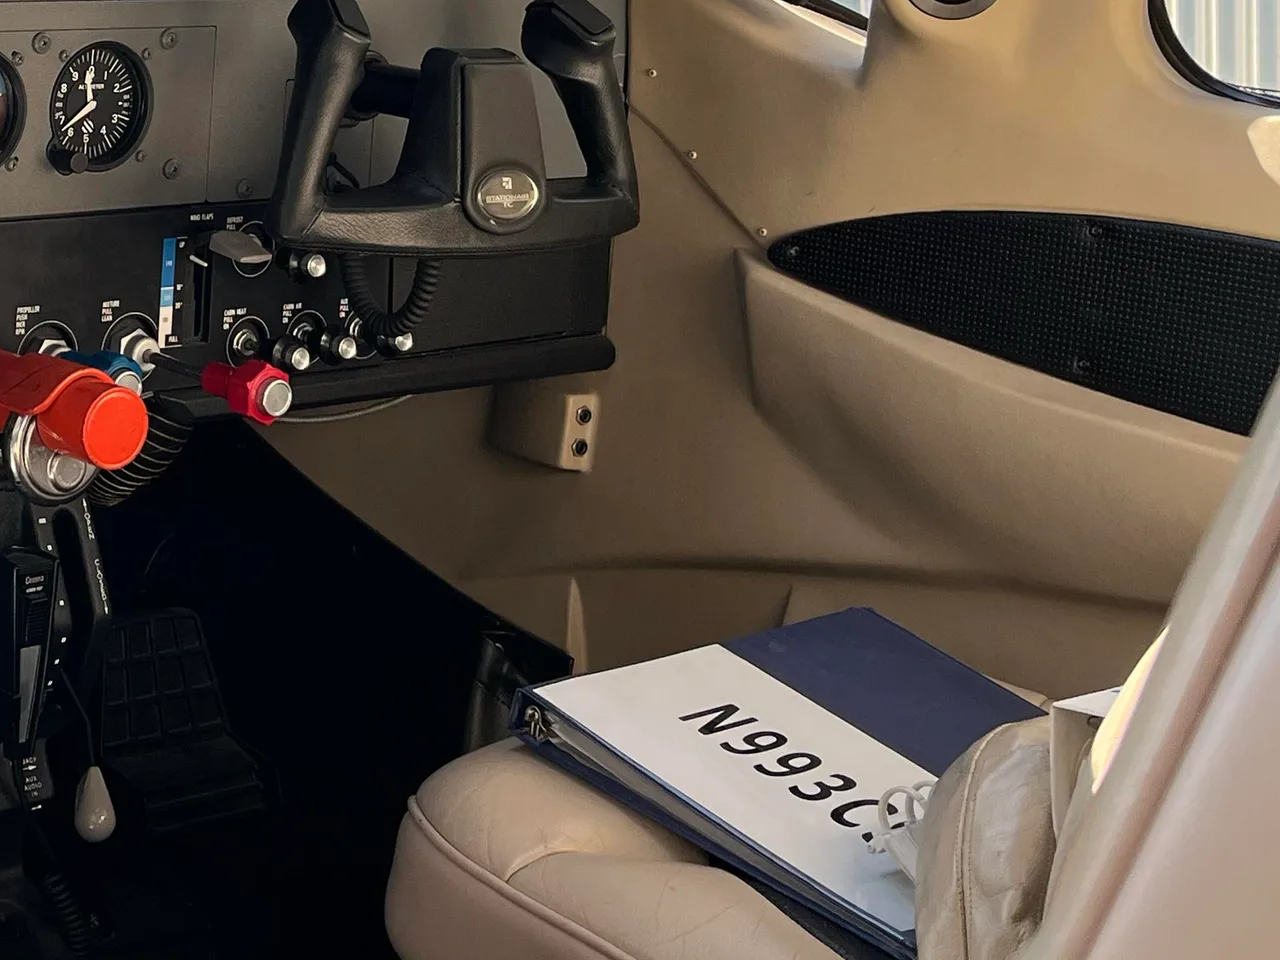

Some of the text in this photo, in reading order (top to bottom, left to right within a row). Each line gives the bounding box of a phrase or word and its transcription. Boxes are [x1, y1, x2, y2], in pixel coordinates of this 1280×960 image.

[72, 72, 79, 81] 9
[61, 83, 67, 93] 8
[113, 83, 120, 93] 2
[60, 116, 65, 125] 7
[112, 114, 118, 123] 3
[68, 127, 74, 137] 6
[100, 126, 106, 134] 4
[83, 134, 89, 143] 5
[84, 512, 95, 540] OPEN
[94, 559, 107, 601] CLOSED
[678, 703, 905, 844] N993C
[24, 782, 43, 791] AUDIO
